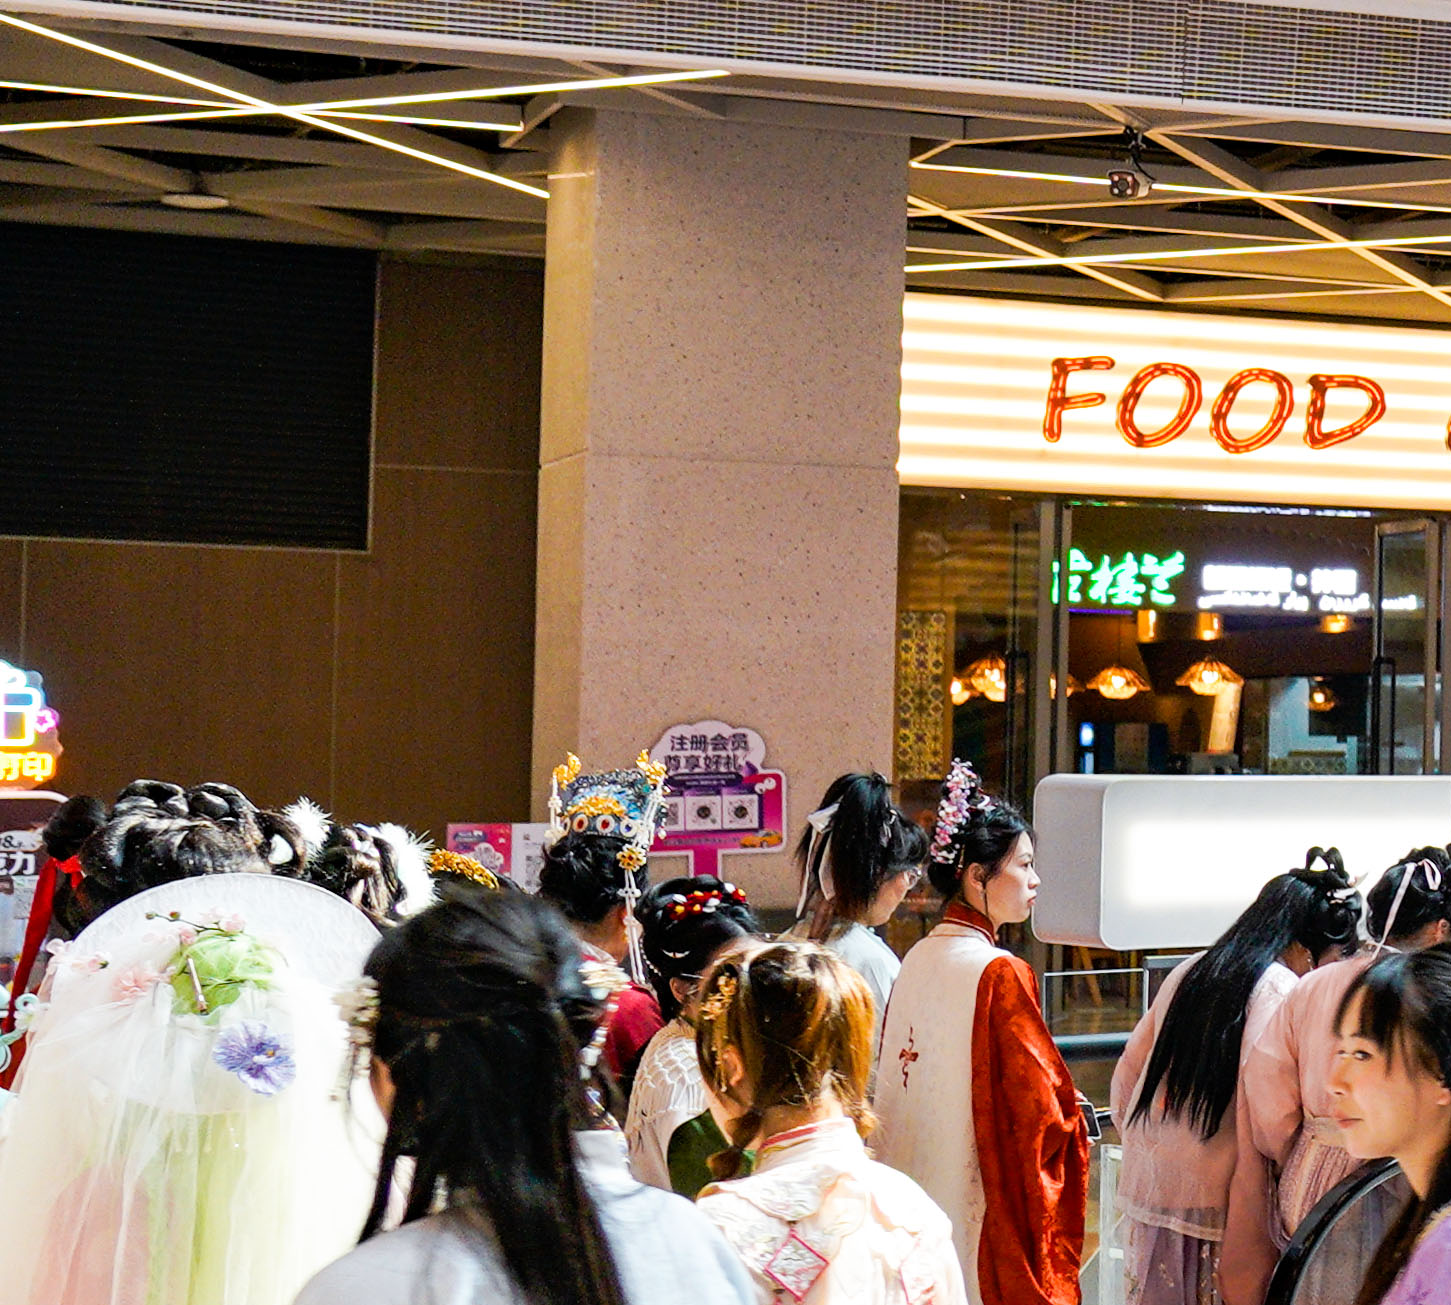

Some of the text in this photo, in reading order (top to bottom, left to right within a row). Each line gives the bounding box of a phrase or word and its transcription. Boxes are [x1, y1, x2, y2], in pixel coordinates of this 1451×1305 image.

[1041, 353, 1388, 456] FOOD
[670, 733, 750, 753] 注册会员
[664, 754, 743, 773] 尊享好礼
